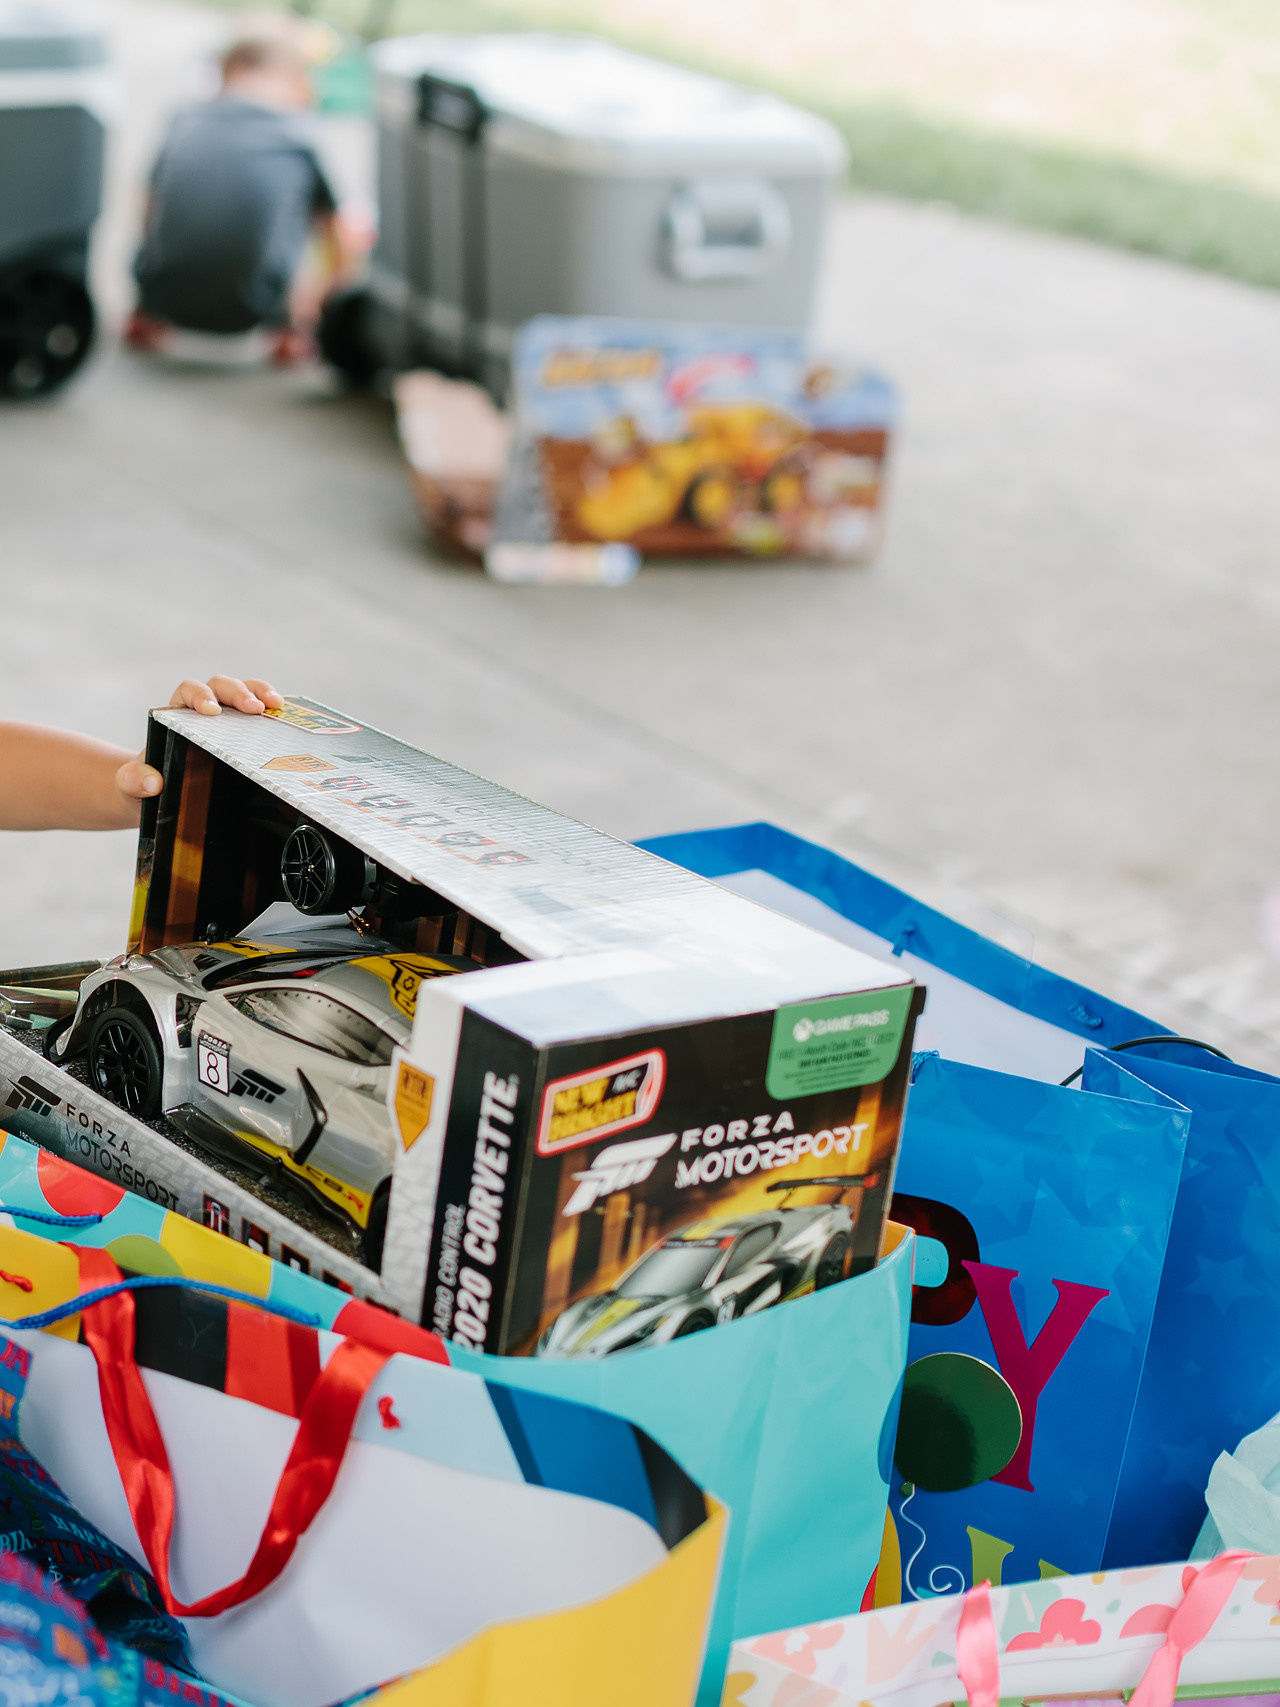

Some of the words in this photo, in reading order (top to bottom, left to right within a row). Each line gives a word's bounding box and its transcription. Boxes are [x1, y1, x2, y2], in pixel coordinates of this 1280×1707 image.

[207, 1052, 220, 1085] 8
[66, 1102, 132, 1159] FORZA
[674, 1122, 869, 1189] MOTORSPORT
[680, 1110, 795, 1153] FORZA
[65, 1122, 180, 1211] MOTORSPORT
[437, 1203, 467, 1287] CONTROL
